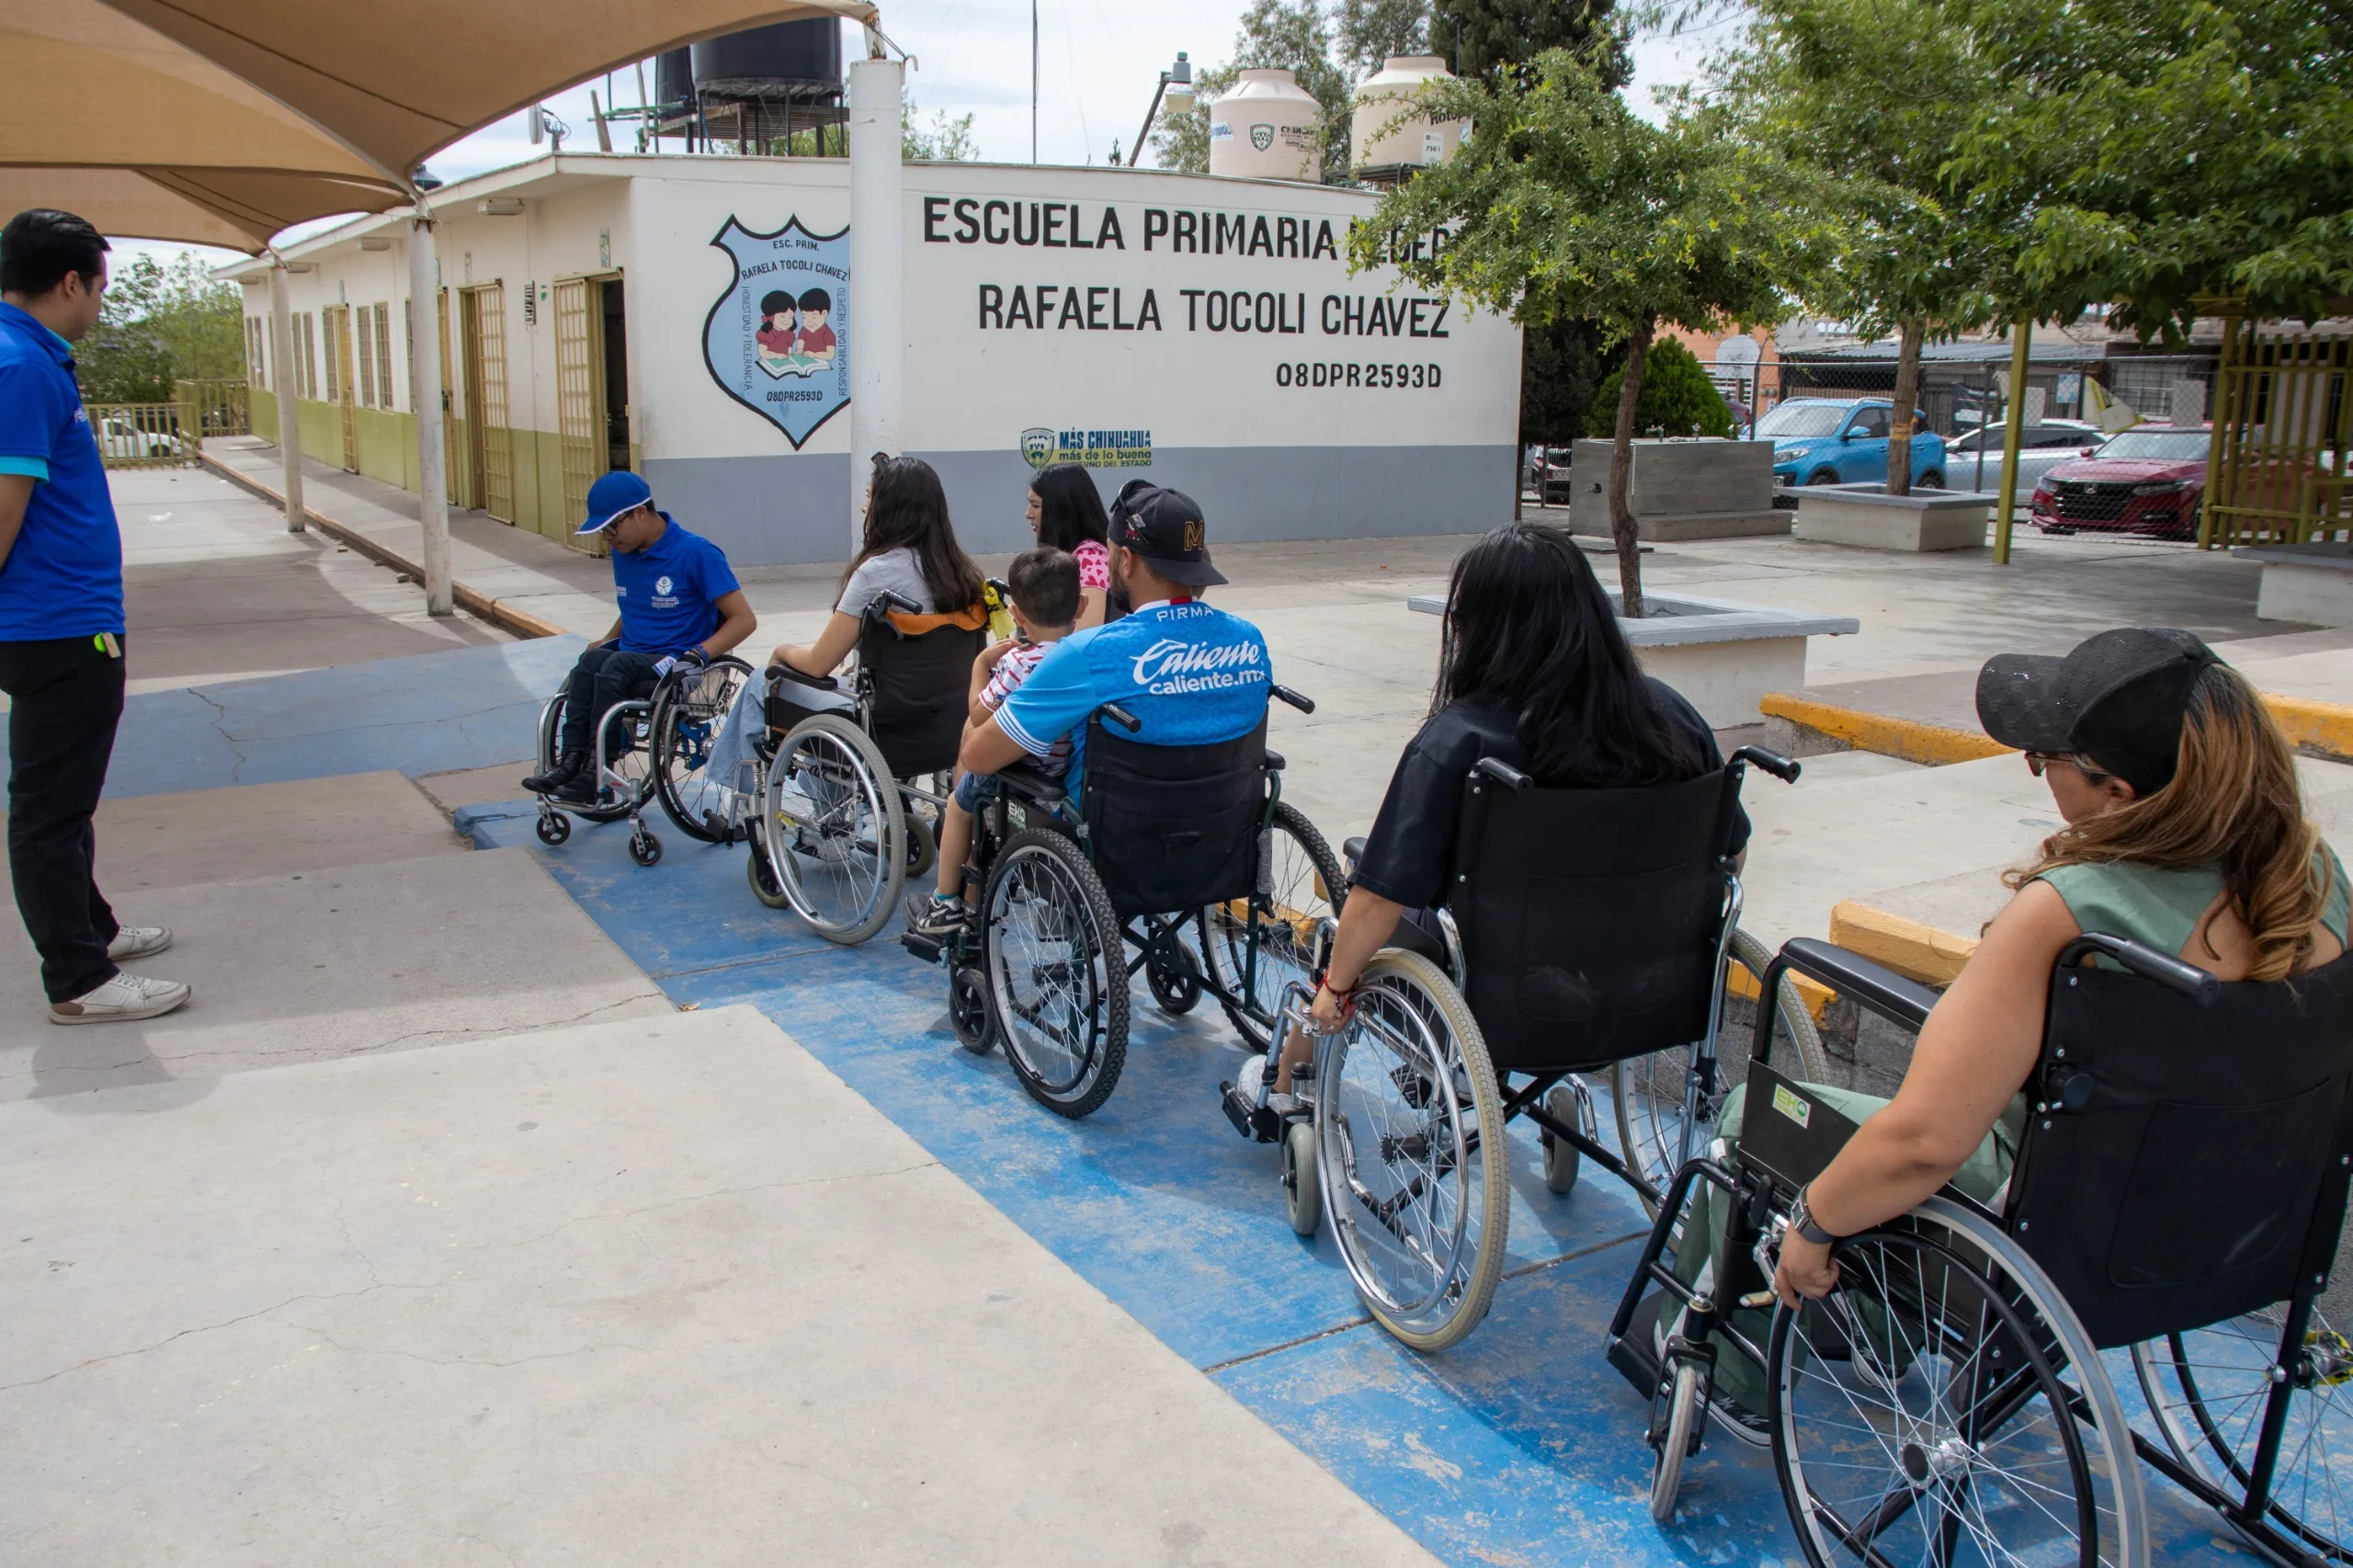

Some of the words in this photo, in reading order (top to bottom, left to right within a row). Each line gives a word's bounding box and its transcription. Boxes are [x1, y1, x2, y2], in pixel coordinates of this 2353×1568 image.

[924, 197, 1126, 250] ESCUELA
[1144, 209, 1337, 260] PRIMARIA
[773, 239, 793, 249] ESC.
[796, 239, 819, 251] PRIM.
[741, 261, 778, 280] RAFAELA
[779, 259, 813, 271] TOCOLI
[815, 263, 847, 281] CHAVEZ
[741, 286, 751, 332] HONESTIDAD
[837, 287, 846, 321] RESPETO
[980, 284, 1162, 332] RAFAELA
[1179, 290, 1305, 335] TOCOLI
[1321, 294, 1449, 338] CHAVEZ
[743, 340, 753, 391] TOLERANCIA
[838, 330, 847, 396] RESPONSABILIDAD
[1276, 363, 1442, 389] 08DPR2593D
[767, 391, 823, 402] 08DPR2593D
[1059, 426, 1084, 449] MÁS
[1088, 430, 1151, 449] CHIHUAHUA
[1059, 450, 1081, 460] más
[1086, 449, 1099, 460] de
[1103, 449, 1113, 460] lo
[1117, 449, 1152, 460] bueno
[1184, 520, 1203, 551] M
[1156, 607, 1214, 622] PIRMA
[1130, 639, 1260, 685] Caliente
[1149, 669, 1266, 696] caliente.mx
[1777, 1087, 1807, 1118] EKO
